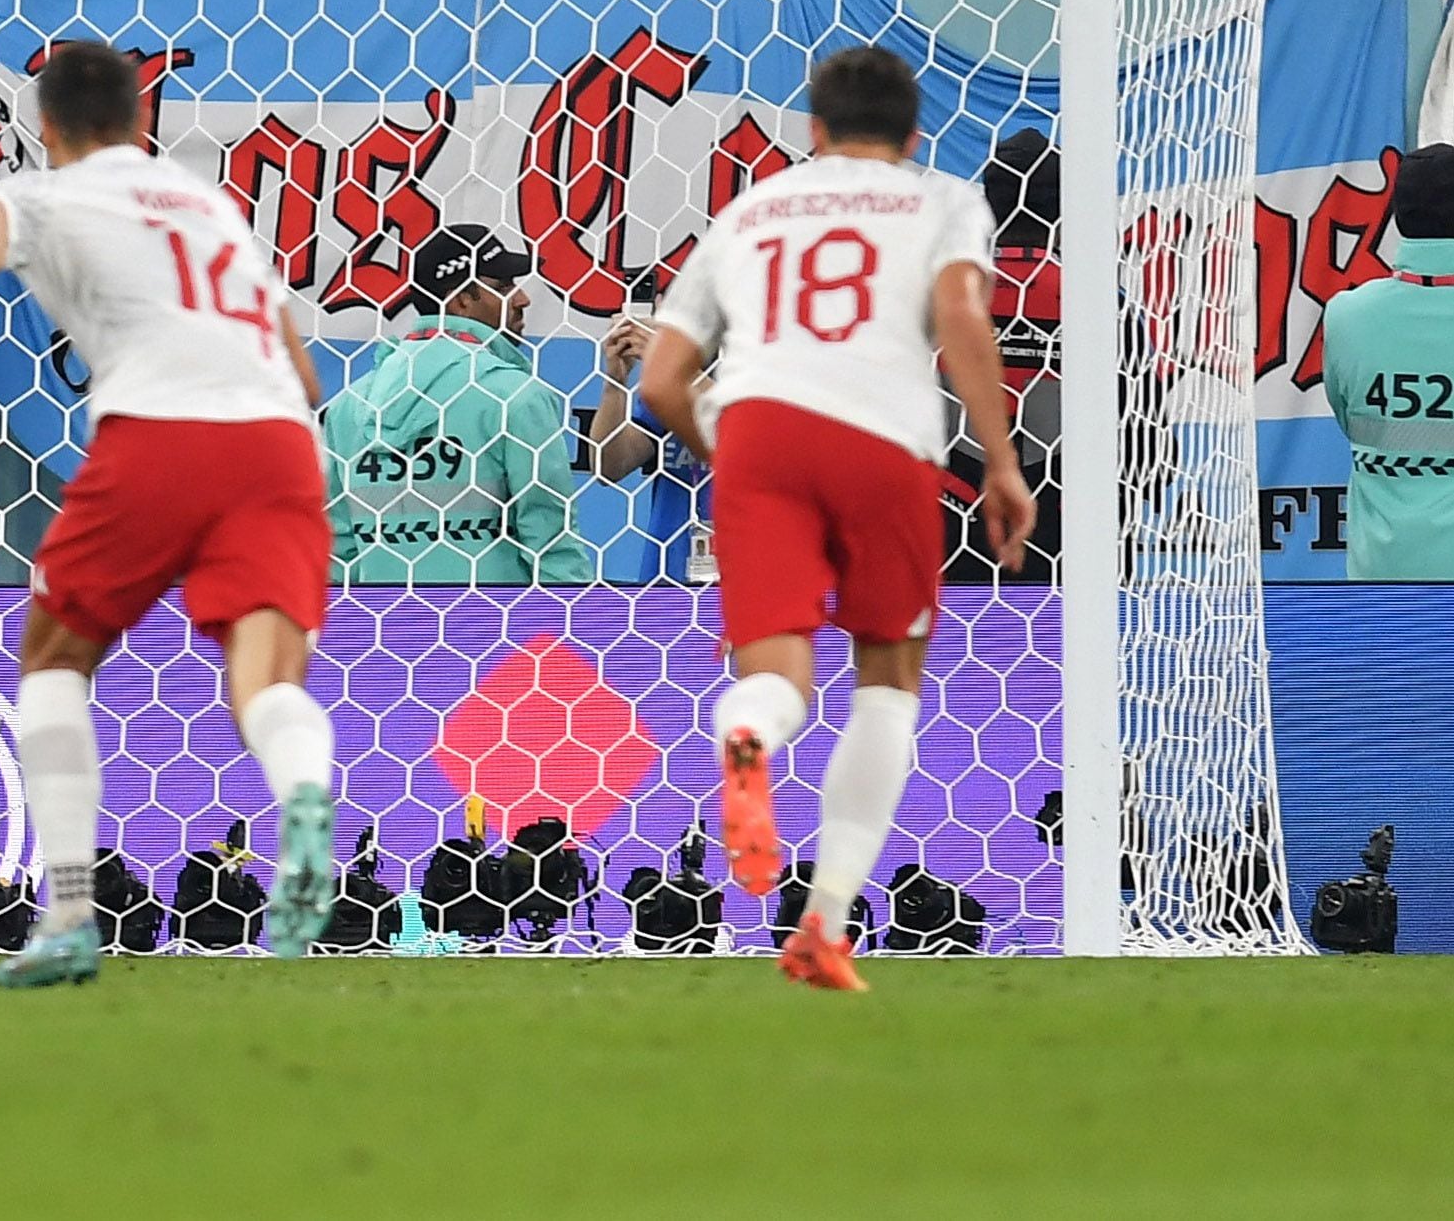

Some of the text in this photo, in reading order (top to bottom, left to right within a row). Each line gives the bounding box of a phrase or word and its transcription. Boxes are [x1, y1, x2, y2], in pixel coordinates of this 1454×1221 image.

[143, 215, 276, 353] 14
[755, 227, 880, 345] 18
[356, 436, 463, 483] 4559
